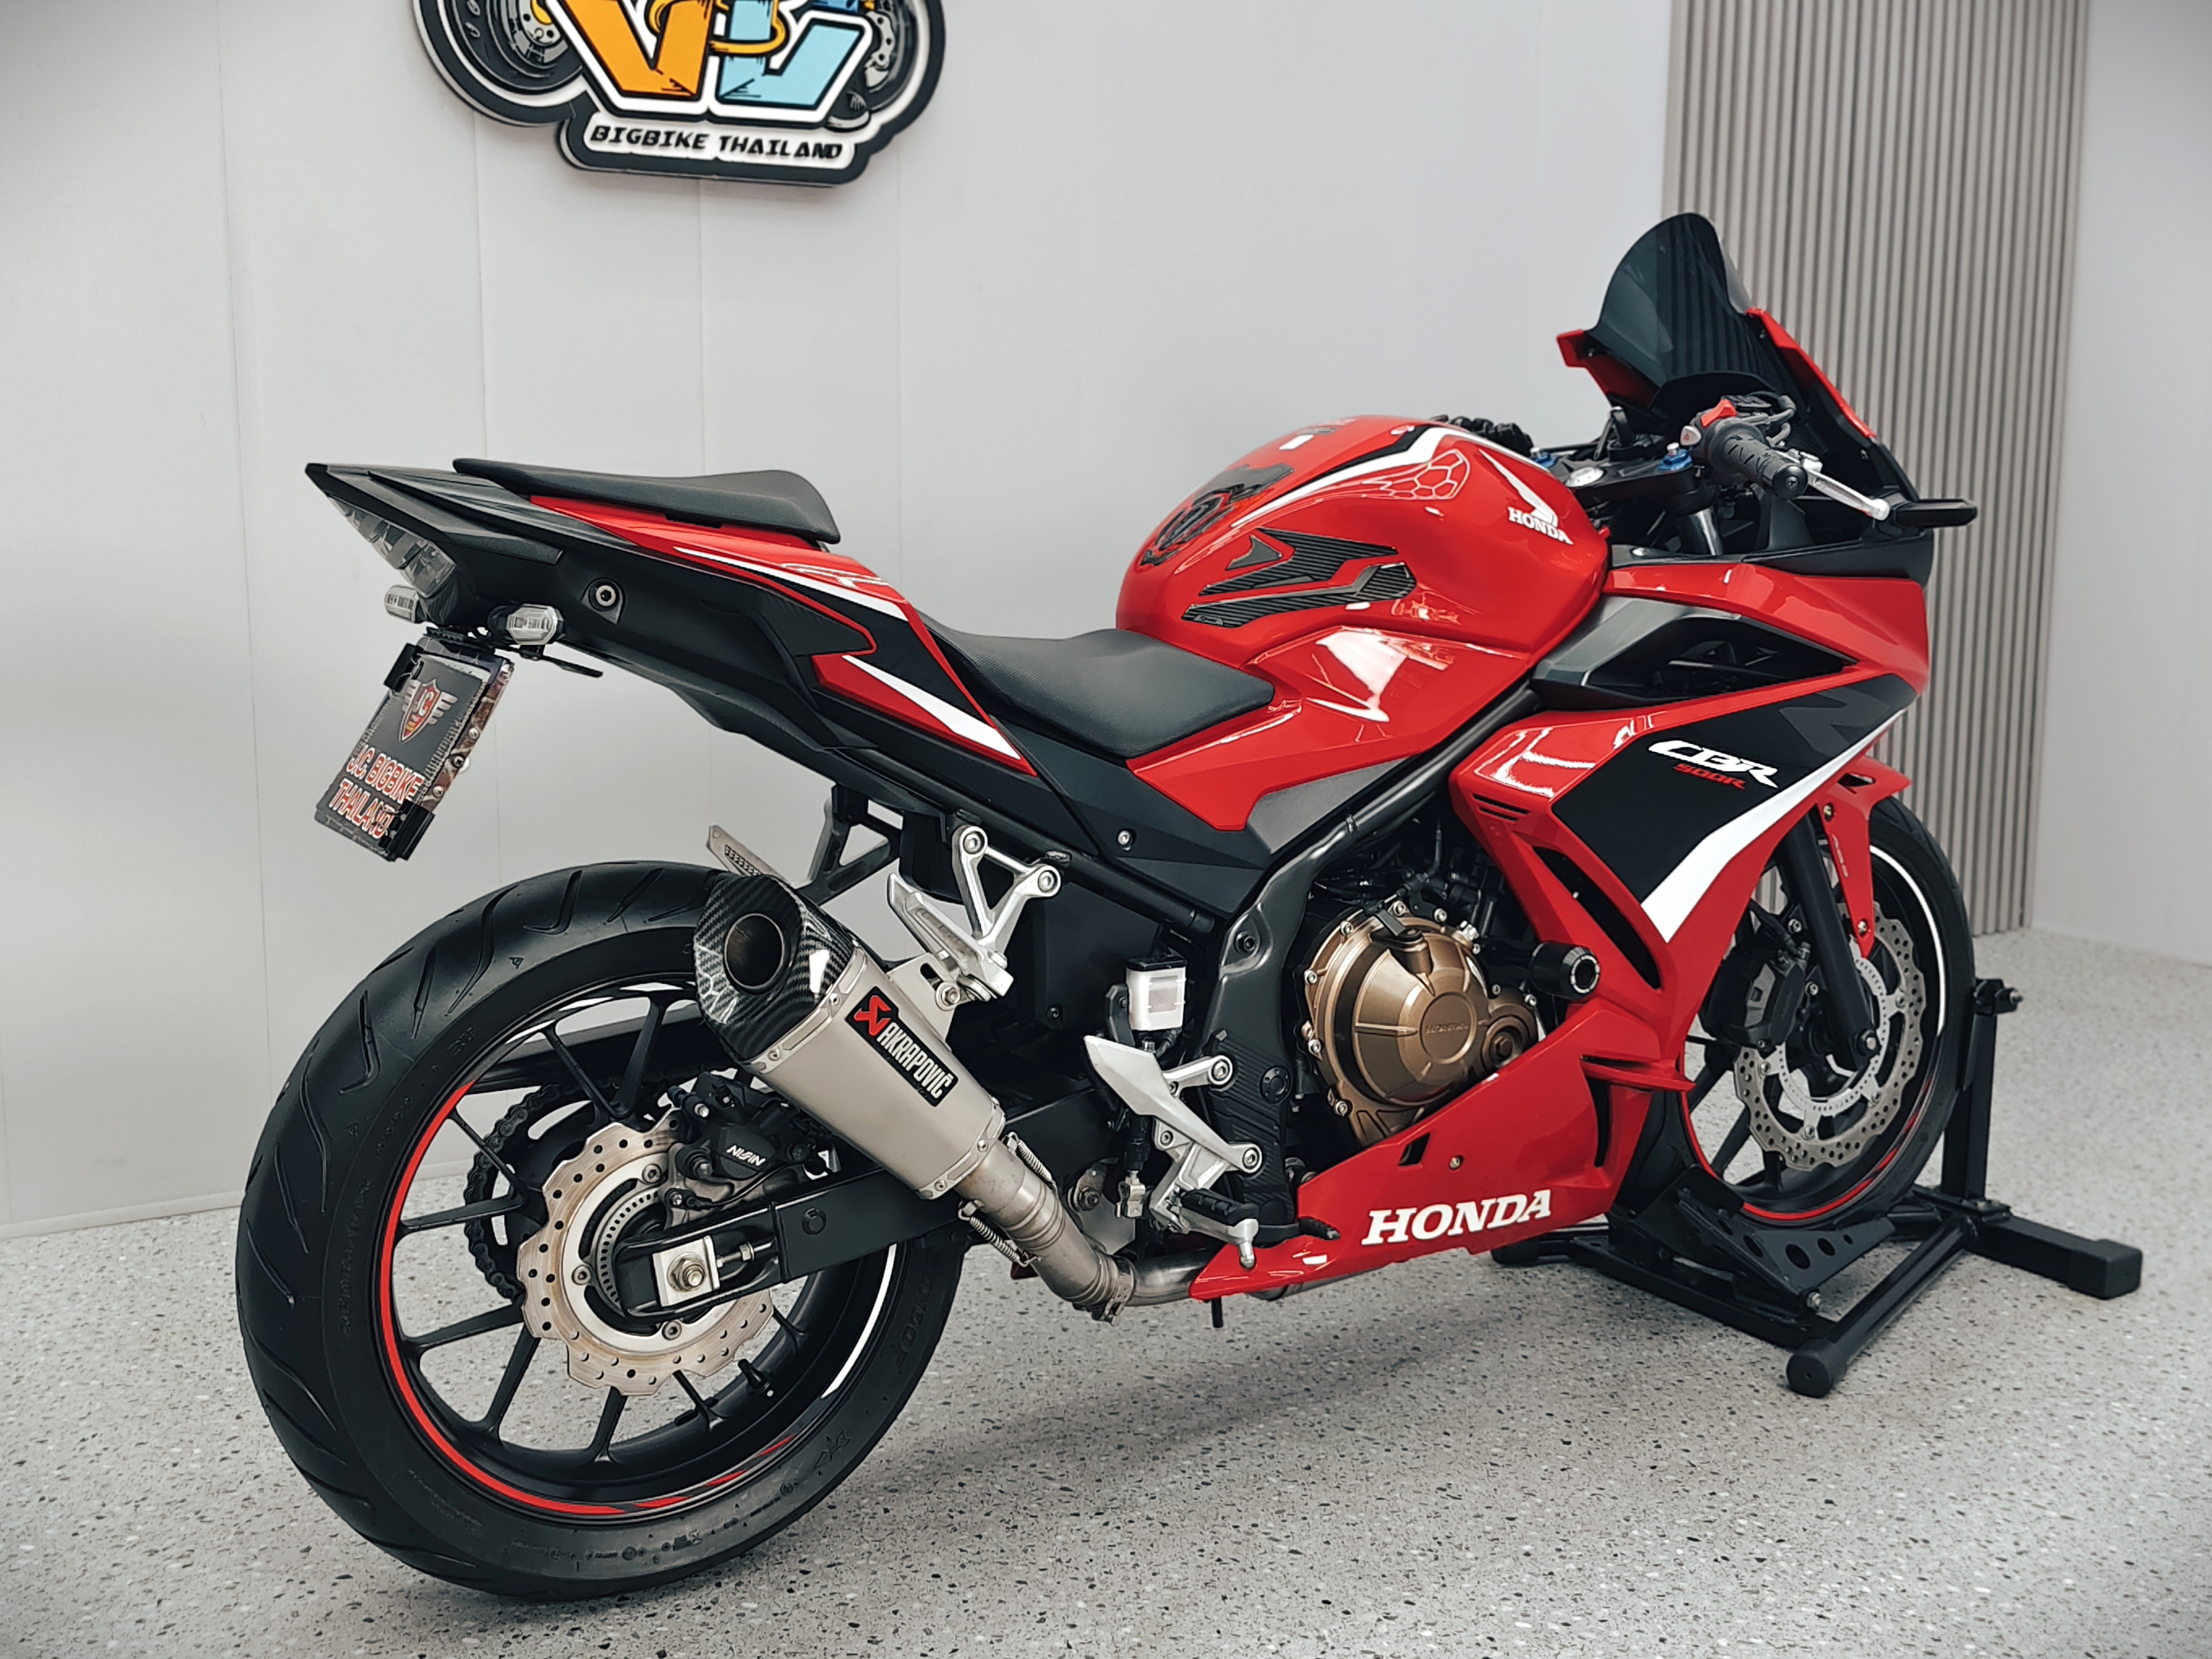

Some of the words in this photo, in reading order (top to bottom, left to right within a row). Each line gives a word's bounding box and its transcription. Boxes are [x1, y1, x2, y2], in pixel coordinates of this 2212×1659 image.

[590, 125, 709, 150] BIGBIKE
[719, 135, 843, 159] THAILAND
[1507, 506, 1574, 545] HONDA
[365, 752, 426, 804] BIGBIKE
[1648, 739, 1779, 788] CBR
[1674, 763, 1746, 790] 500R
[329, 777, 396, 839] THAILAND
[1361, 1189, 1552, 1245] HONDA
